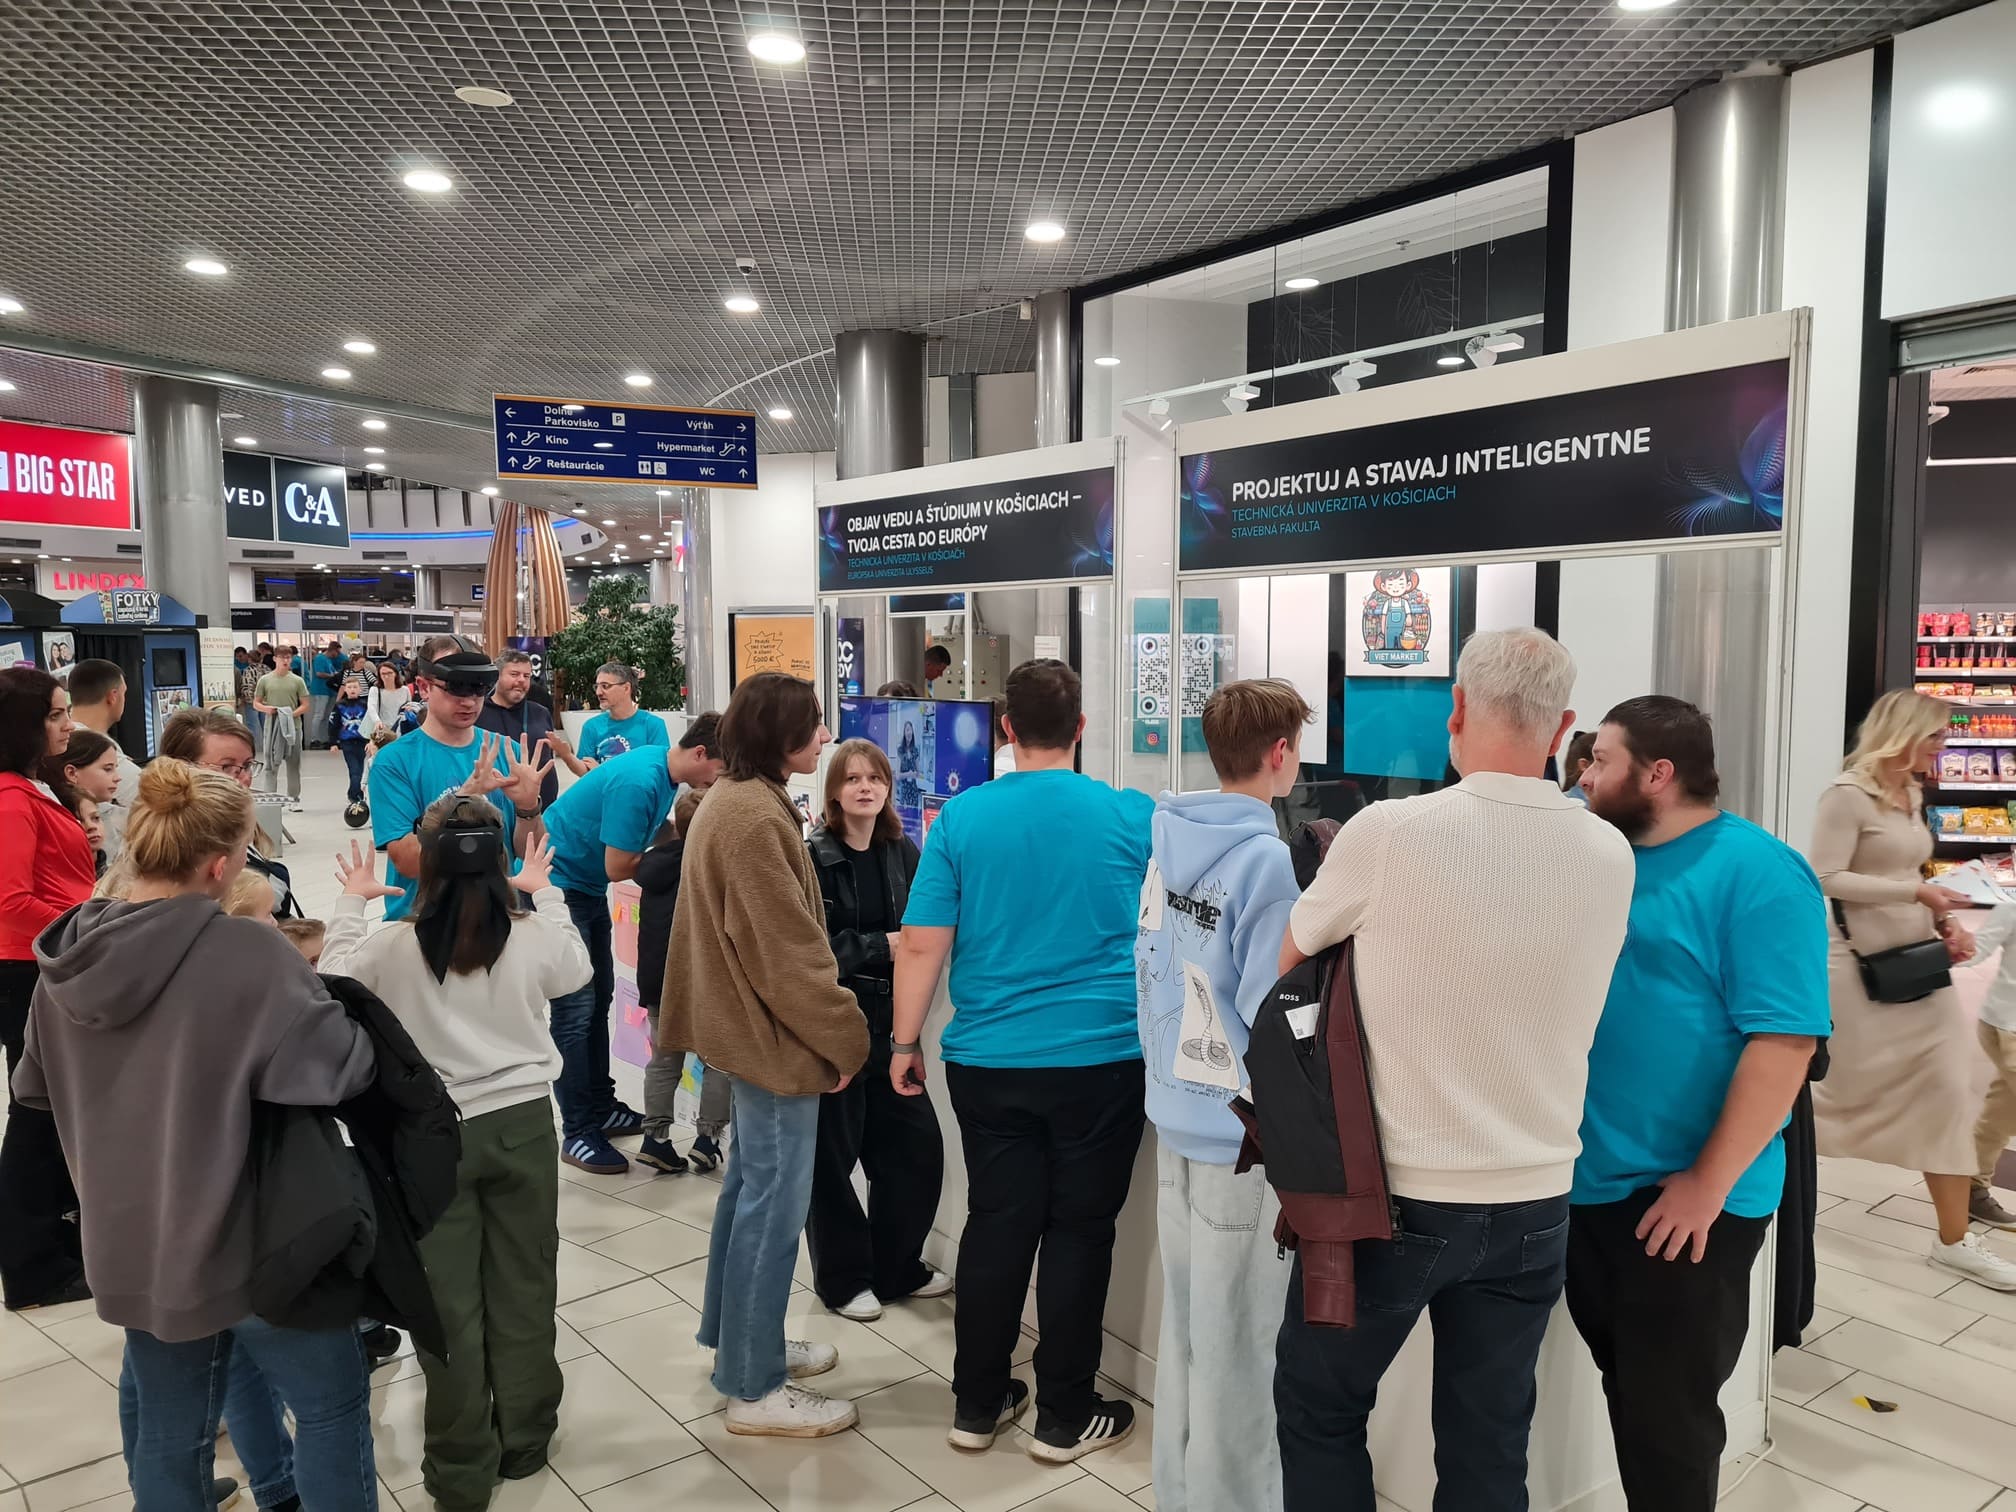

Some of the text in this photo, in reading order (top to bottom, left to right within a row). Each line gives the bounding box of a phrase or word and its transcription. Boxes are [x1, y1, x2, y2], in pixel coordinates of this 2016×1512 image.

[544, 416, 600, 428] Parkovisko
[686, 419, 714, 431] Výťah
[545, 435, 569, 446] Kino
[656, 442, 715, 454] Hypermarket
[546, 459, 605, 471] Reštaurácie
[1232, 426, 1651, 502] PROJEKTUJ A STAVAJ INTELIGENTNE
[15, 453, 116, 501] BIG STAR
[699, 467, 715, 476] WC
[285, 482, 340, 527] C&A
[1297, 496, 1367, 516] UNIVERZITA
[1370, 494, 1380, 507] V
[1383, 485, 1456, 505] KOŠICIACH
[847, 514, 881, 532] OBJAV
[883, 511, 913, 529] VEDU
[915, 510, 924, 525] A
[926, 502, 981, 524] ŠTÚDIUM
[983, 500, 993, 516] V
[996, 490, 1069, 516] KOŠICIACH
[1279, 520, 1321, 534] FAKULTA
[848, 524, 988, 553] TVOJA CESTA DO EURÓPY
[883, 552, 920, 565] UNIVERZITA
[921, 551, 927, 561] V
[928, 547, 966, 561] KOŠICIACH
[876, 567, 905, 578] UNIVERZITA
[116, 592, 158, 607] FOTKY
[1374, 652, 1419, 661] VIET MARKET
[1279, 993, 1300, 1002] BOSS
